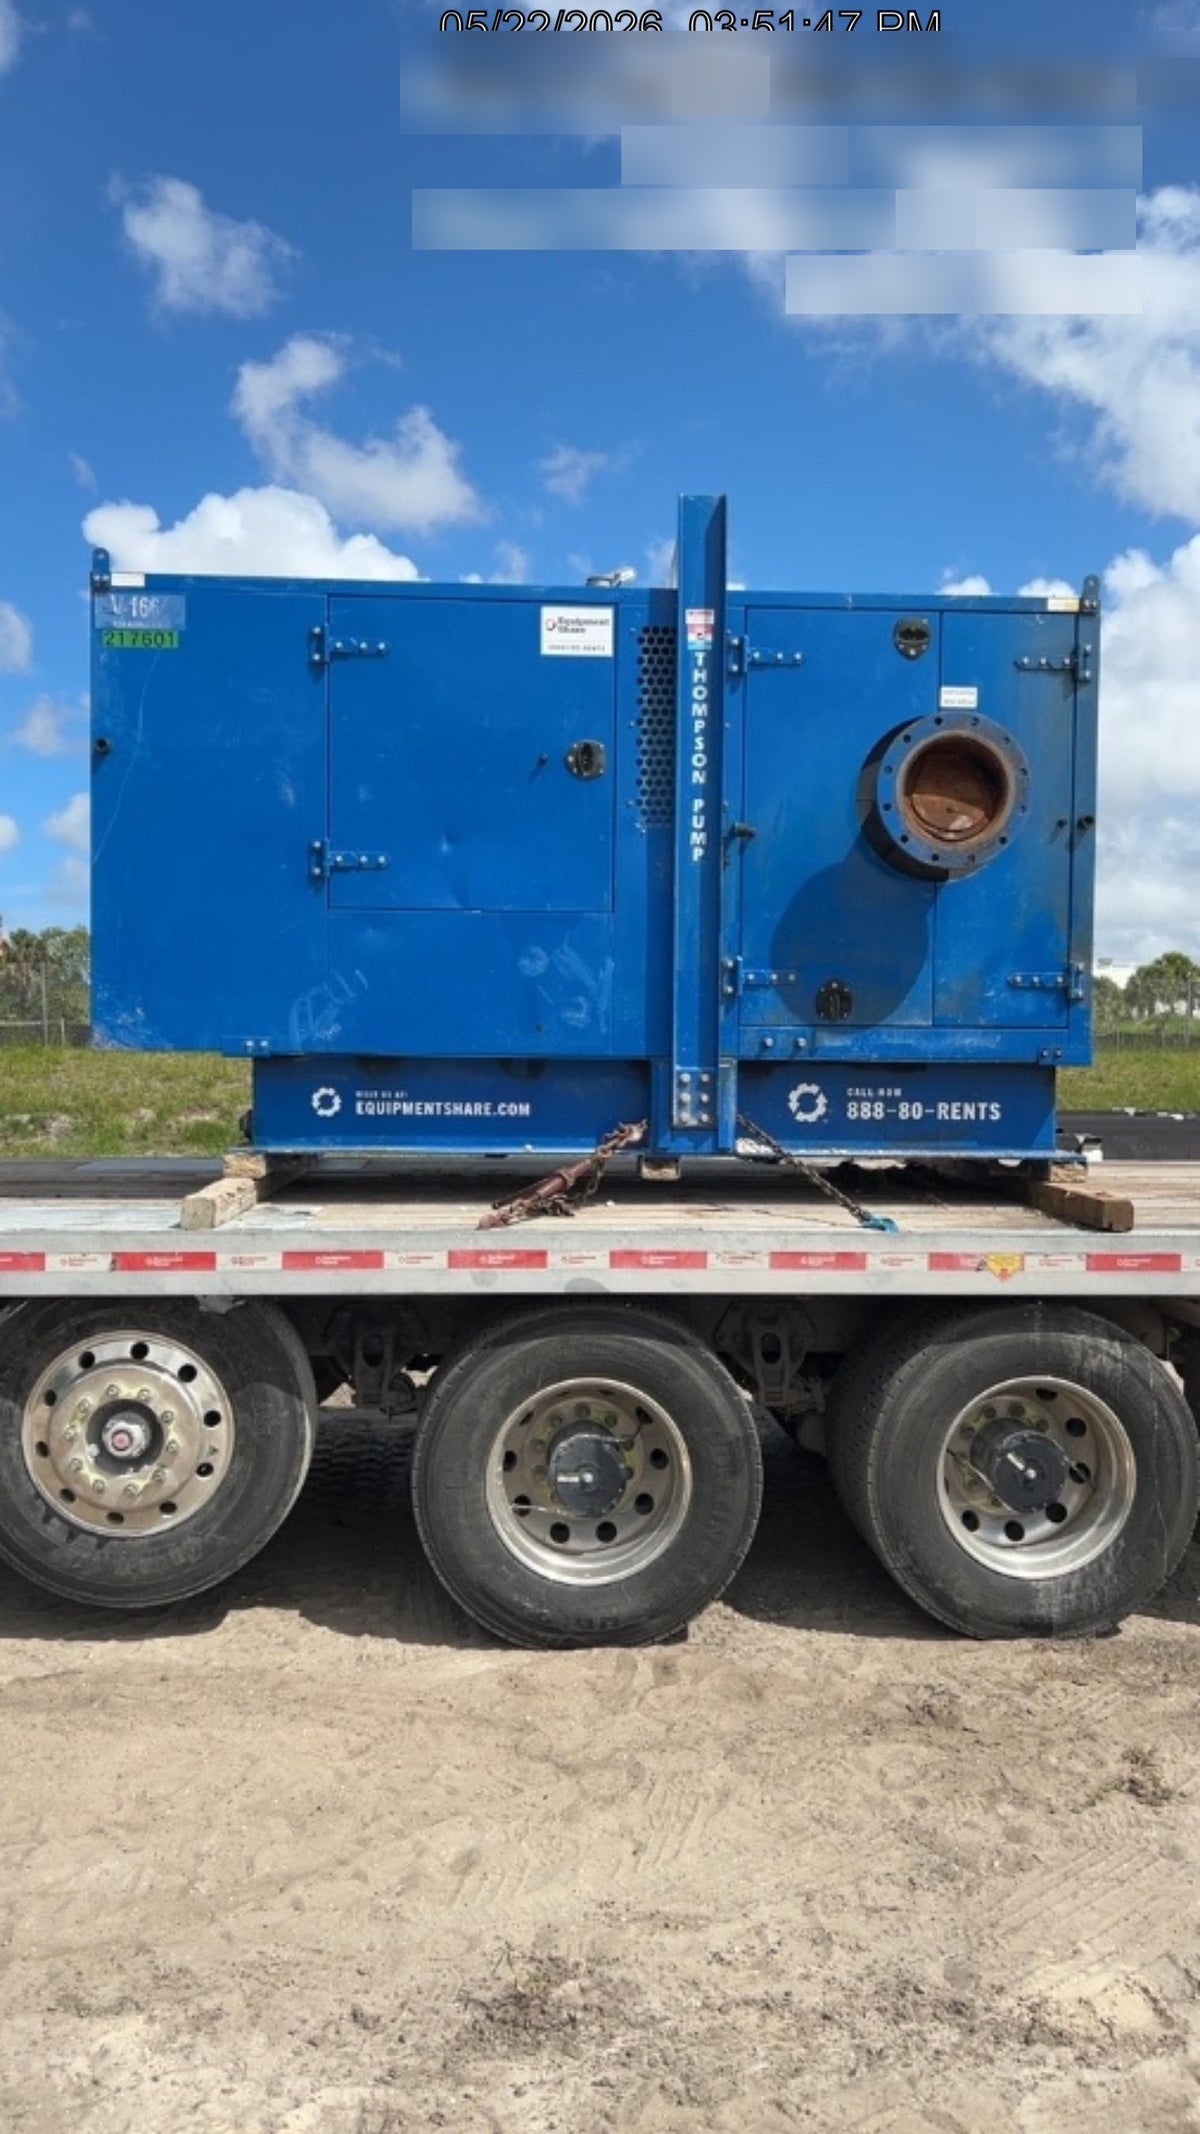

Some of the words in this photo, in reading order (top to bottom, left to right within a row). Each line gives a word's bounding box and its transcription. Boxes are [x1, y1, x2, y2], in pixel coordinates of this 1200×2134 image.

[103, 631, 175, 647] 217601
[691, 651, 708, 784] THOMPSON
[690, 798, 707, 862] PUMP
[846, 1087, 873, 1098] CALL
[355, 1101, 530, 1116] EQUIPMENTSHARE.COM
[846, 1102, 1001, 1120] 888-80-RENTS
